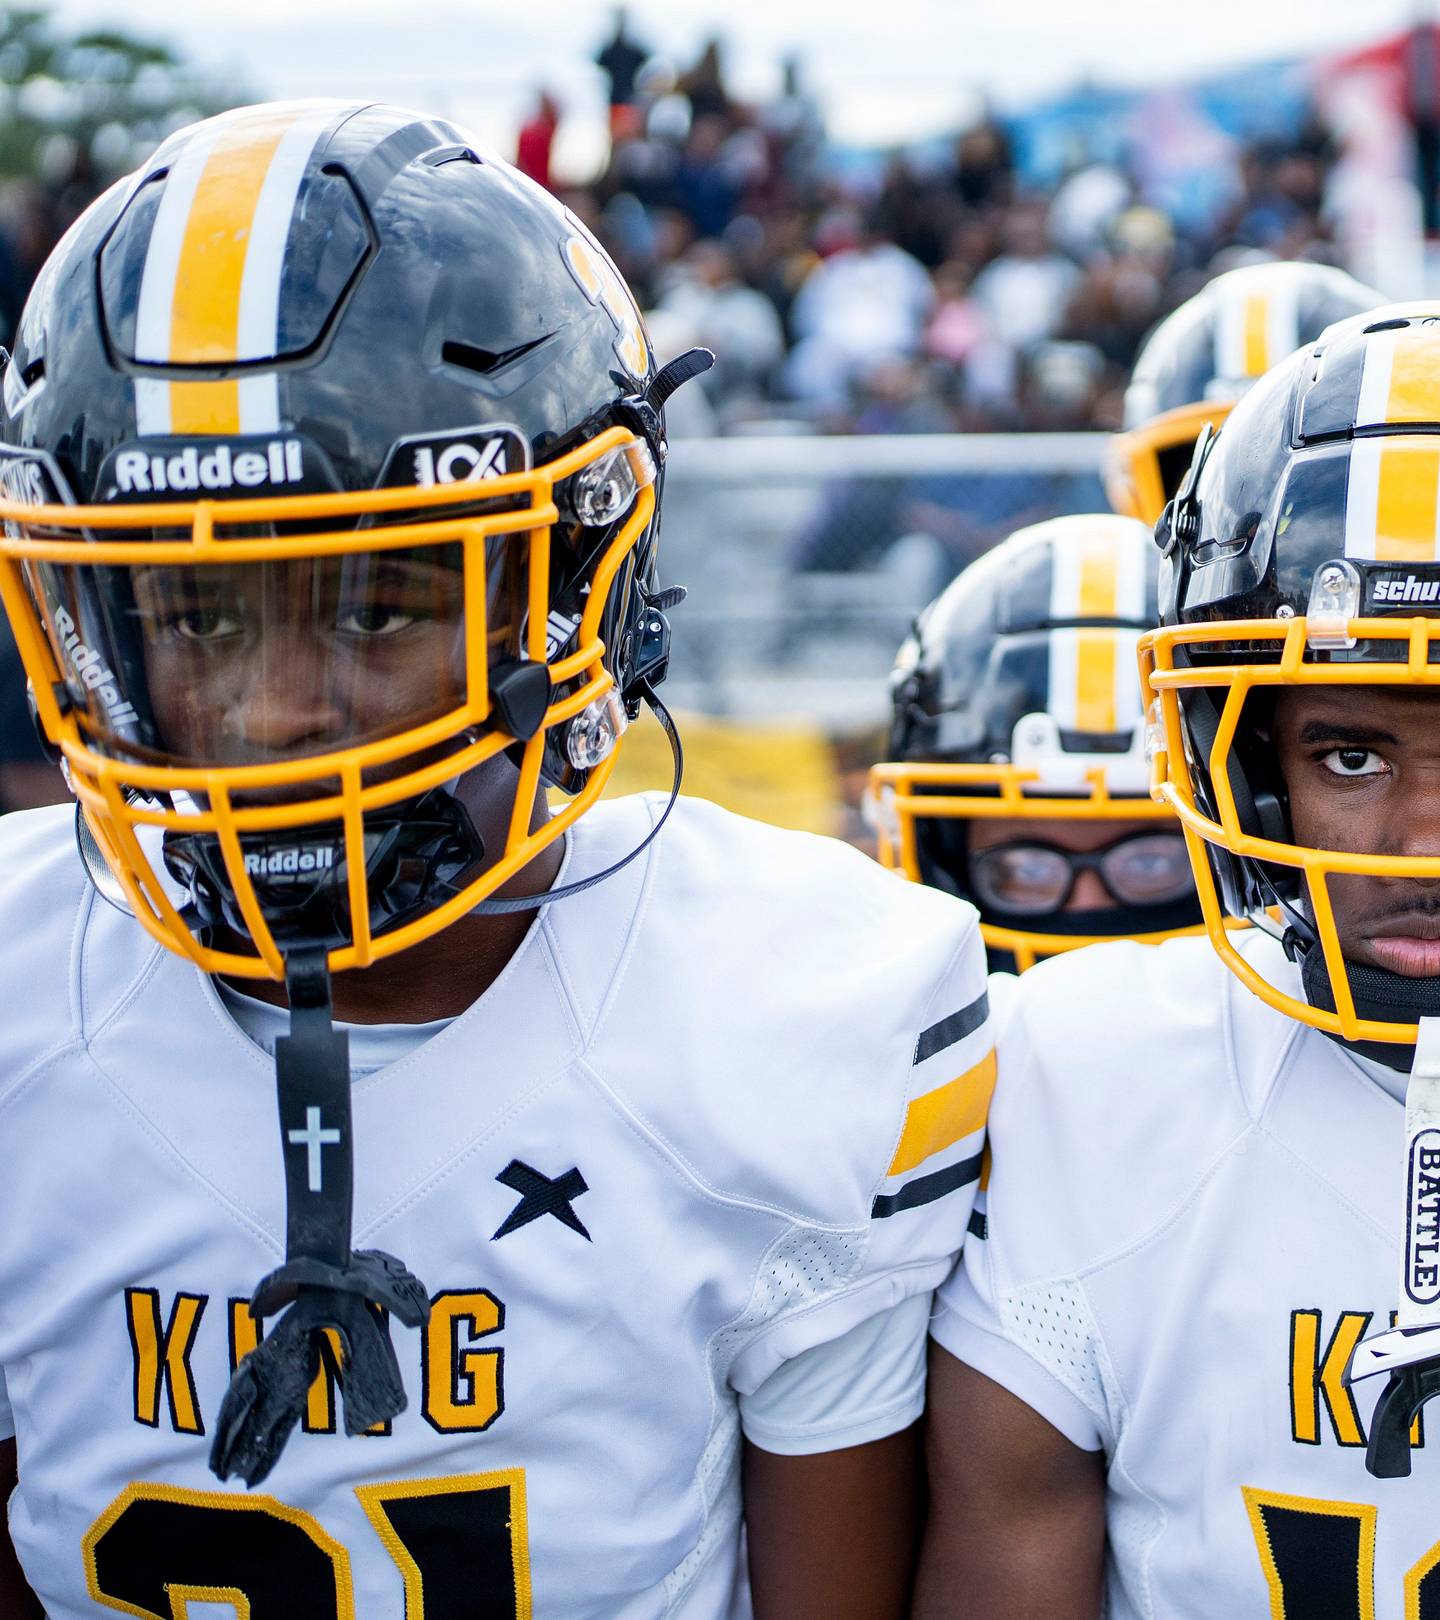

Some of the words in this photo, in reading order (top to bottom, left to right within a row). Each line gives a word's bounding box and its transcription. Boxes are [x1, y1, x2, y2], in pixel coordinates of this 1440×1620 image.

[115, 439, 304, 493] Riddell
[54, 604, 140, 727] Riddell
[244, 846, 334, 875] Riddell
